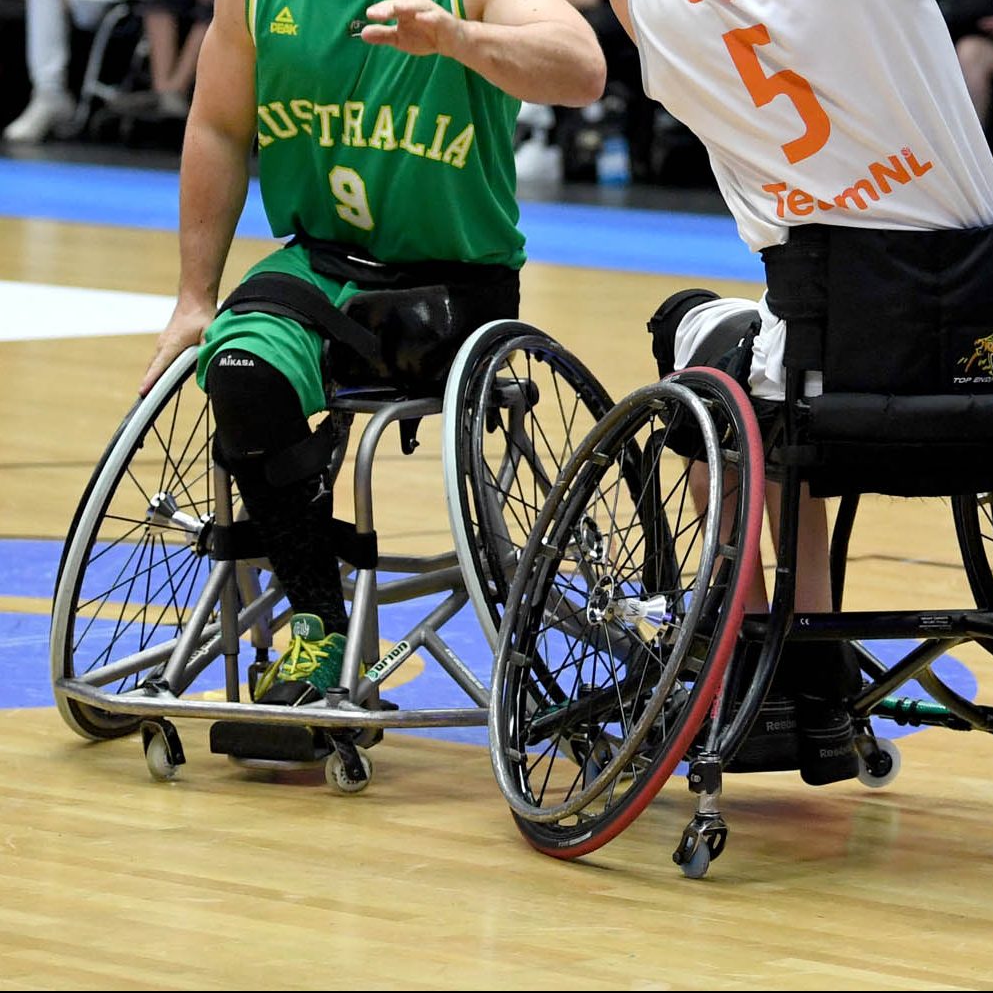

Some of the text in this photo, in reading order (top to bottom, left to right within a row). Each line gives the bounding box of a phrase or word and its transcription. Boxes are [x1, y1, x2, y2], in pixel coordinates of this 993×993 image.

[269, 22, 299, 36] PEAK
[721, 22, 831, 165] 5
[328, 164, 376, 231] 9
[218, 354, 255, 367] MIKASA
[953, 376, 972, 384] TOP
